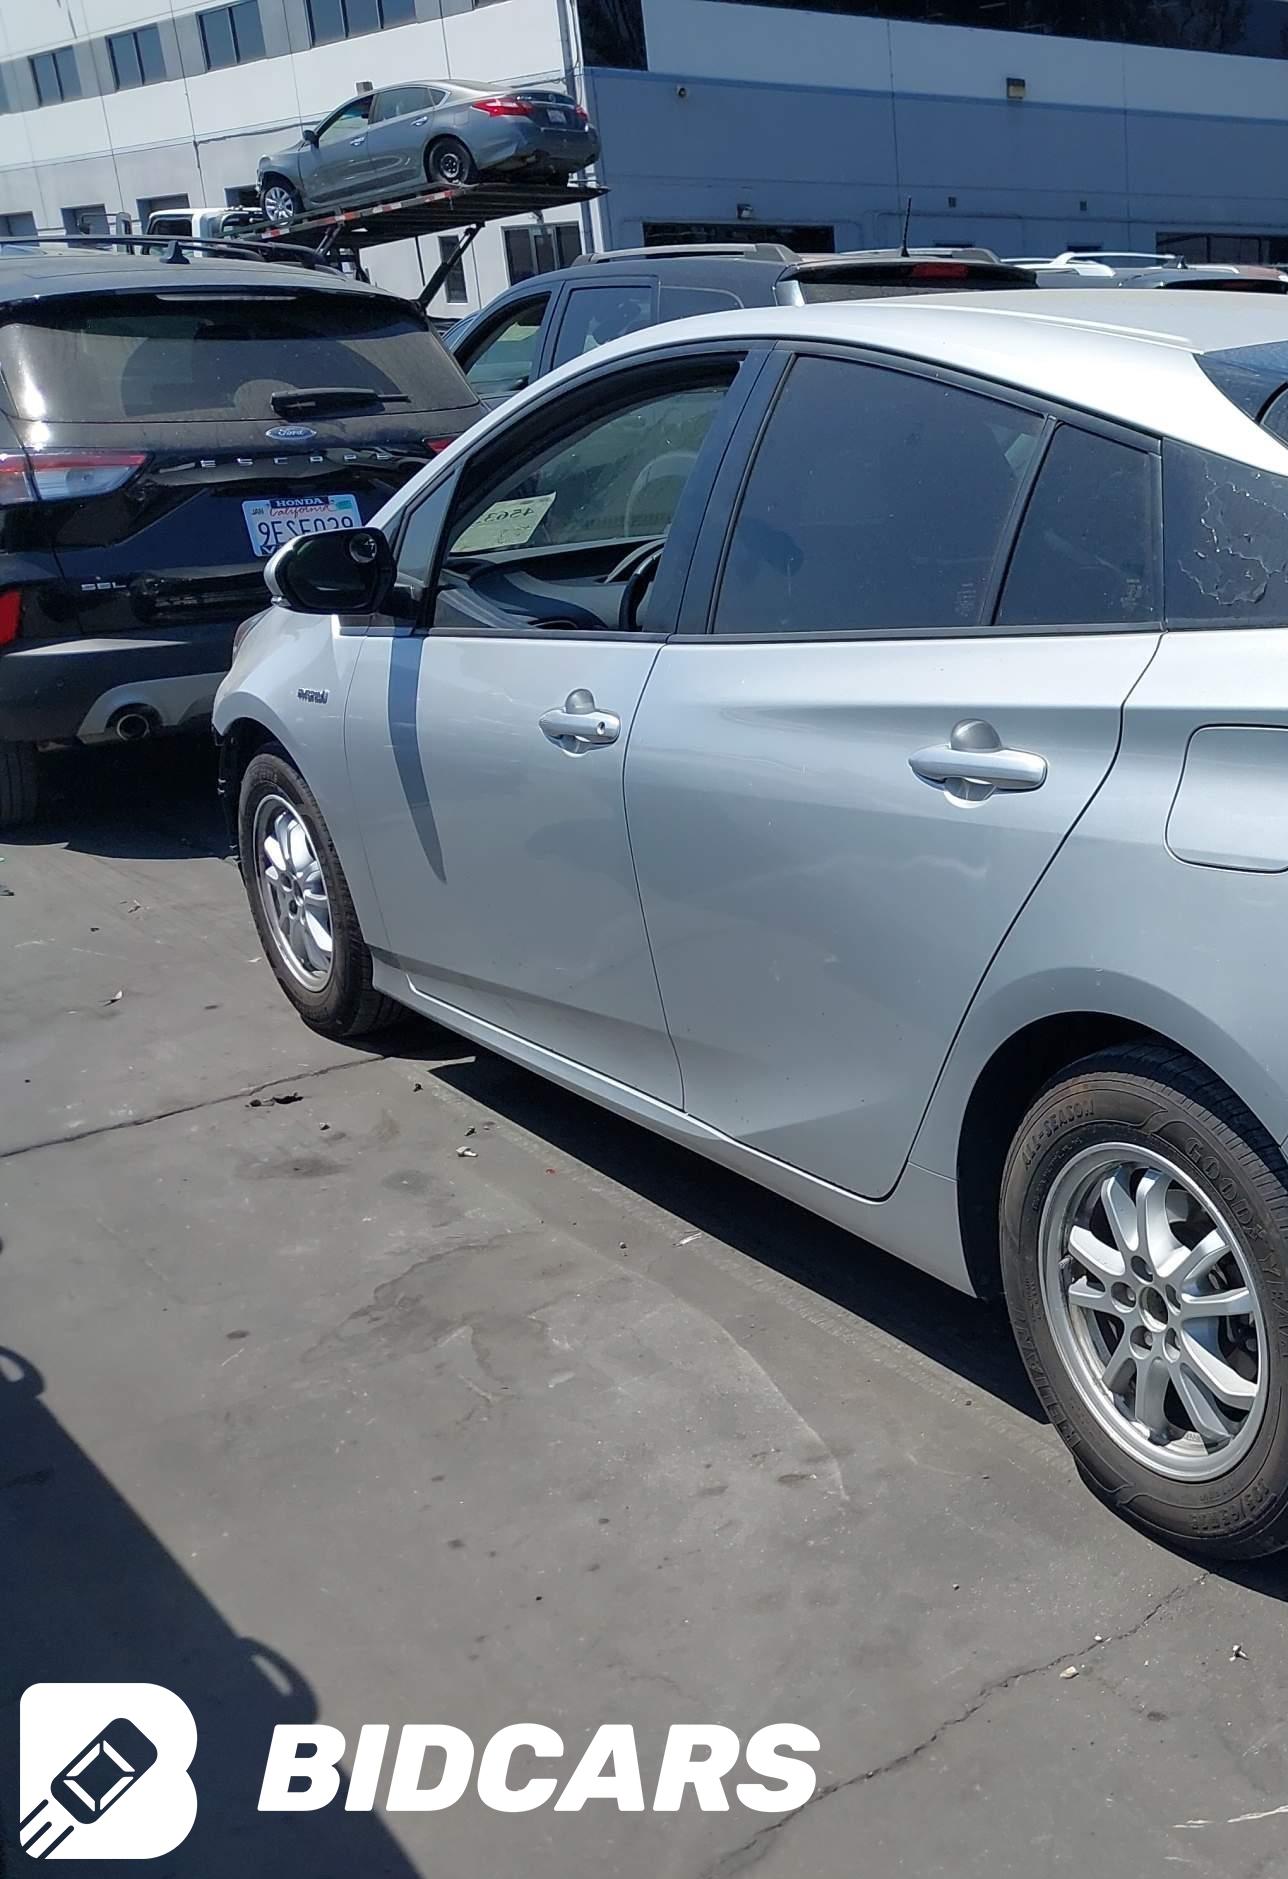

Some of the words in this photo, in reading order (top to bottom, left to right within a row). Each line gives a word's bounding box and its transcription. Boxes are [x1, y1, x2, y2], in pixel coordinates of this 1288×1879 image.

[200, 452, 389, 469] ESCAPE
[276, 498, 323, 507] HONDA
[270, 504, 336, 518] California
[1021, 1100, 1095, 1170] ALL-SEASON
